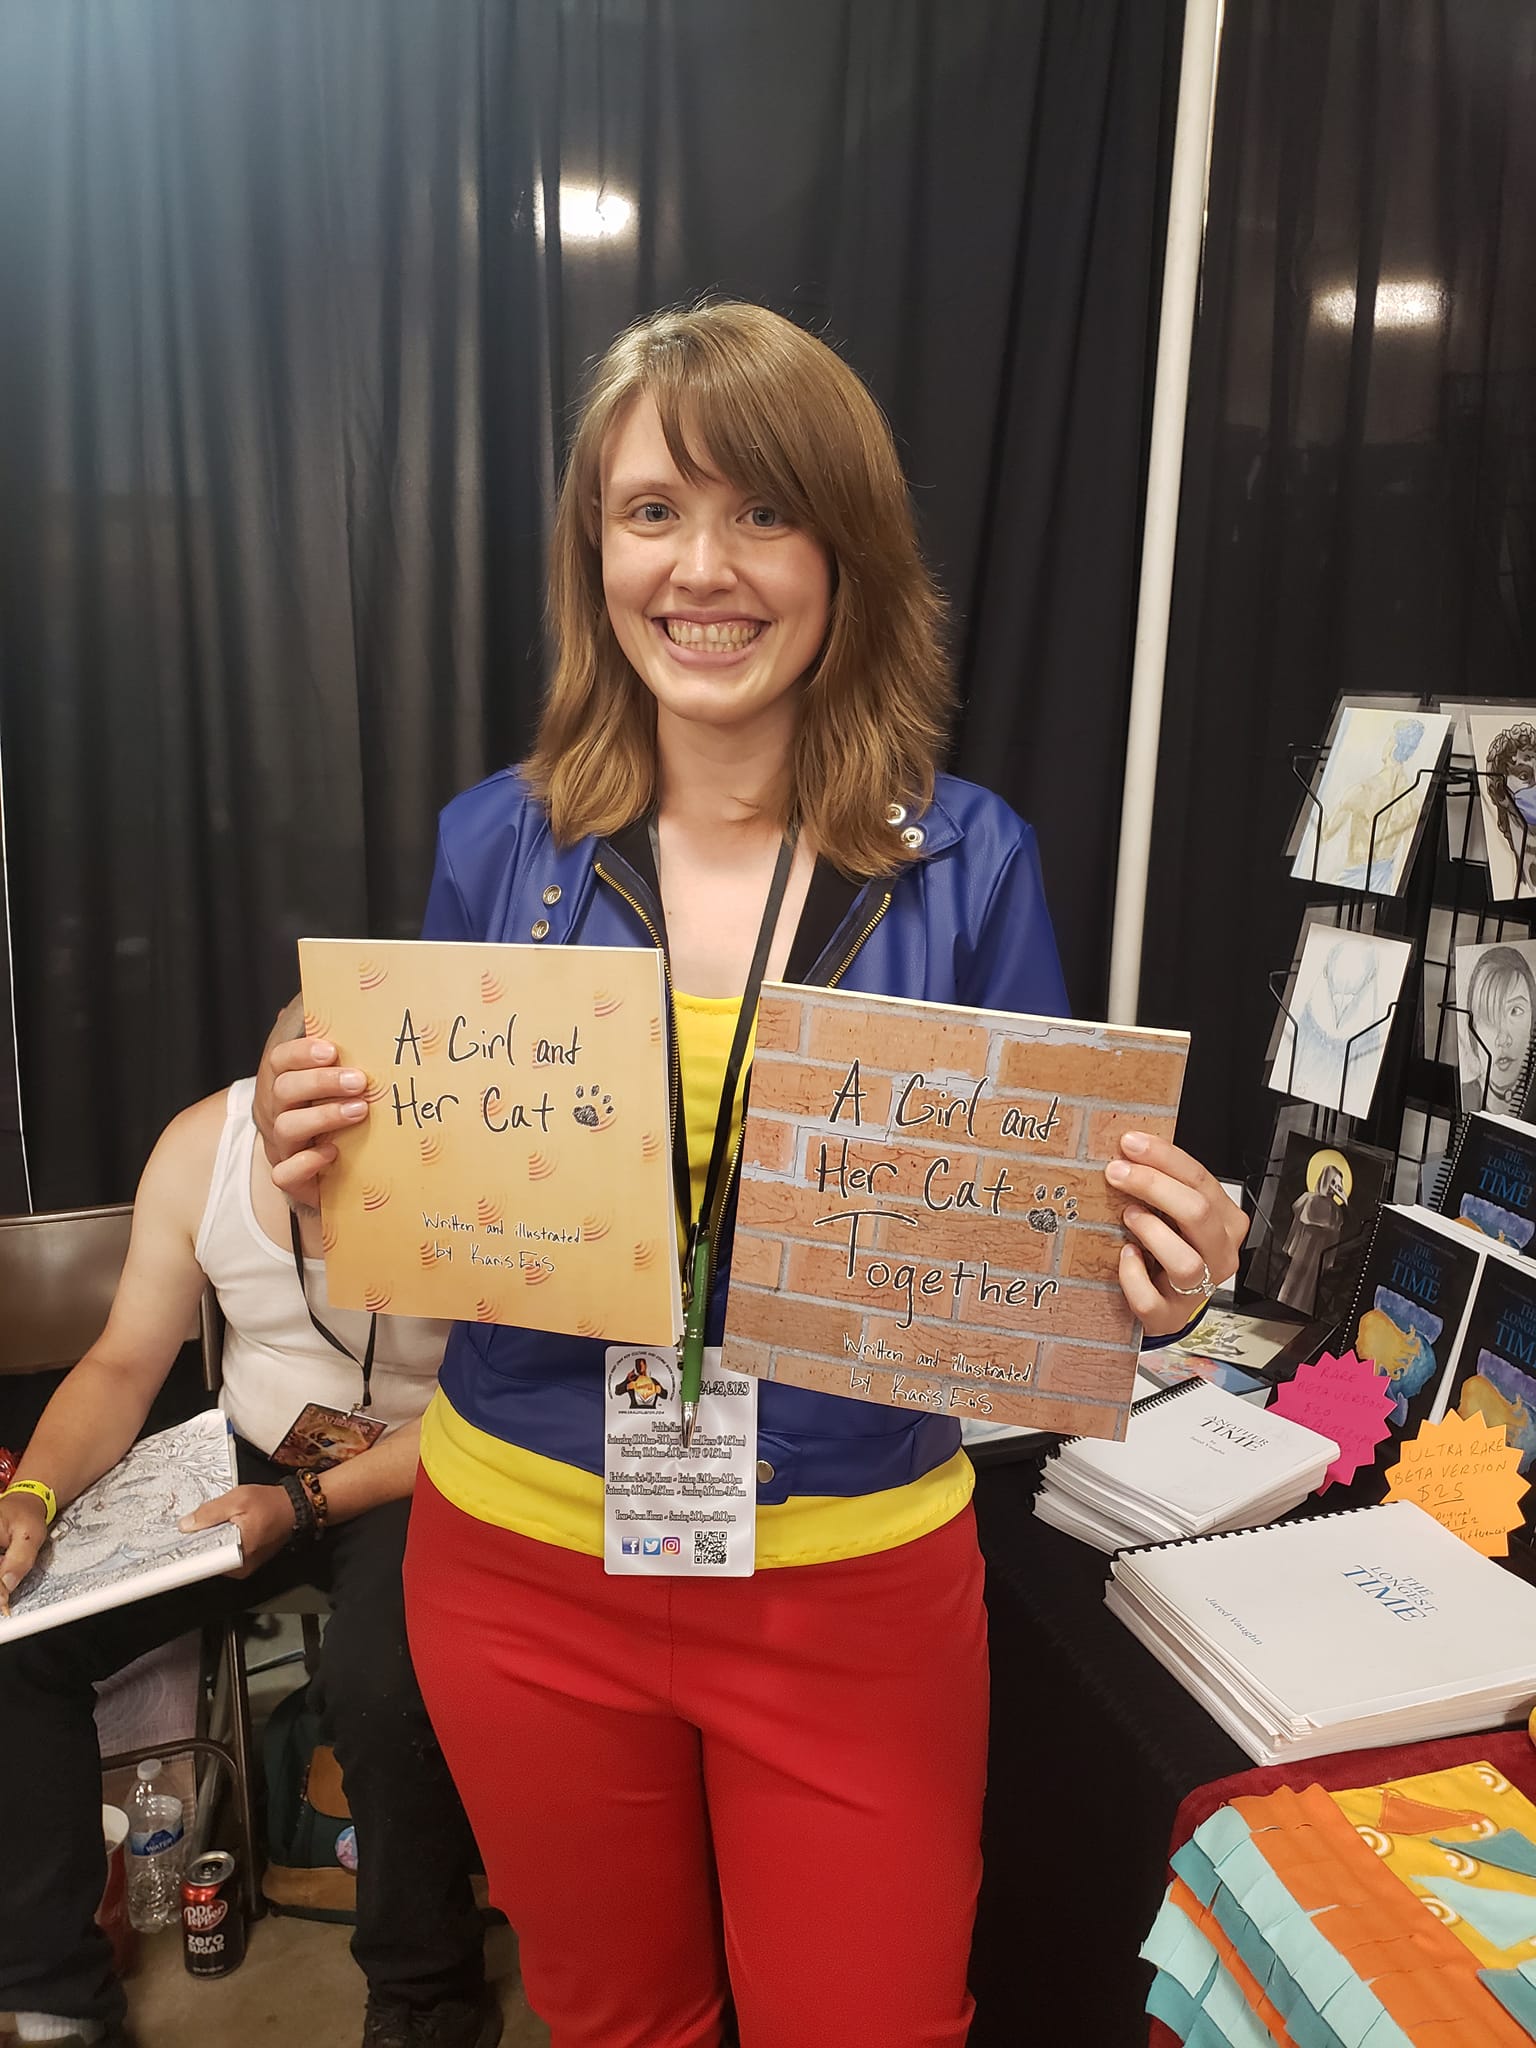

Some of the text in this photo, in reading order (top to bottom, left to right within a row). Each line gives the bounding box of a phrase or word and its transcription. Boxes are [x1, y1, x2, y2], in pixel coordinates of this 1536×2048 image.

[393, 1008, 584, 1067] A Girl and
[391, 1077, 556, 1132] Her Cat
[828, 1059, 1060, 1142] A Girl and
[814, 1140, 1013, 1216] Her Cat
[1478, 1166, 1534, 1210] TIME
[422, 1211, 580, 1244] Written and illustrated
[434, 1242, 453, 1261] by
[470, 1244, 514, 1269] Karis
[813, 1208, 1060, 1329] Together
[1397, 1247, 1443, 1278] LONGEST
[1414, 1242, 1433, 1261] THE
[1391, 1257, 1441, 1305] TIME
[843, 1332, 1032, 1383] Written and illustrated
[1495, 1319, 1536, 1370] TIM
[849, 1368, 871, 1394] by
[891, 1374, 943, 1408] Karis
[1200, 1417, 1257, 1452] TIME
[1408, 1438, 1504, 1463] ULTRA RARE
[1394, 1460, 1507, 1486] BETA VERSION
[1417, 1482, 1464, 1503] $25
[1341, 1564, 1427, 1622] TIME
[1370, 1565, 1439, 1612] LONGEST
[1402, 1576, 1434, 1597] THE
[187, 1933, 225, 1948] zero
